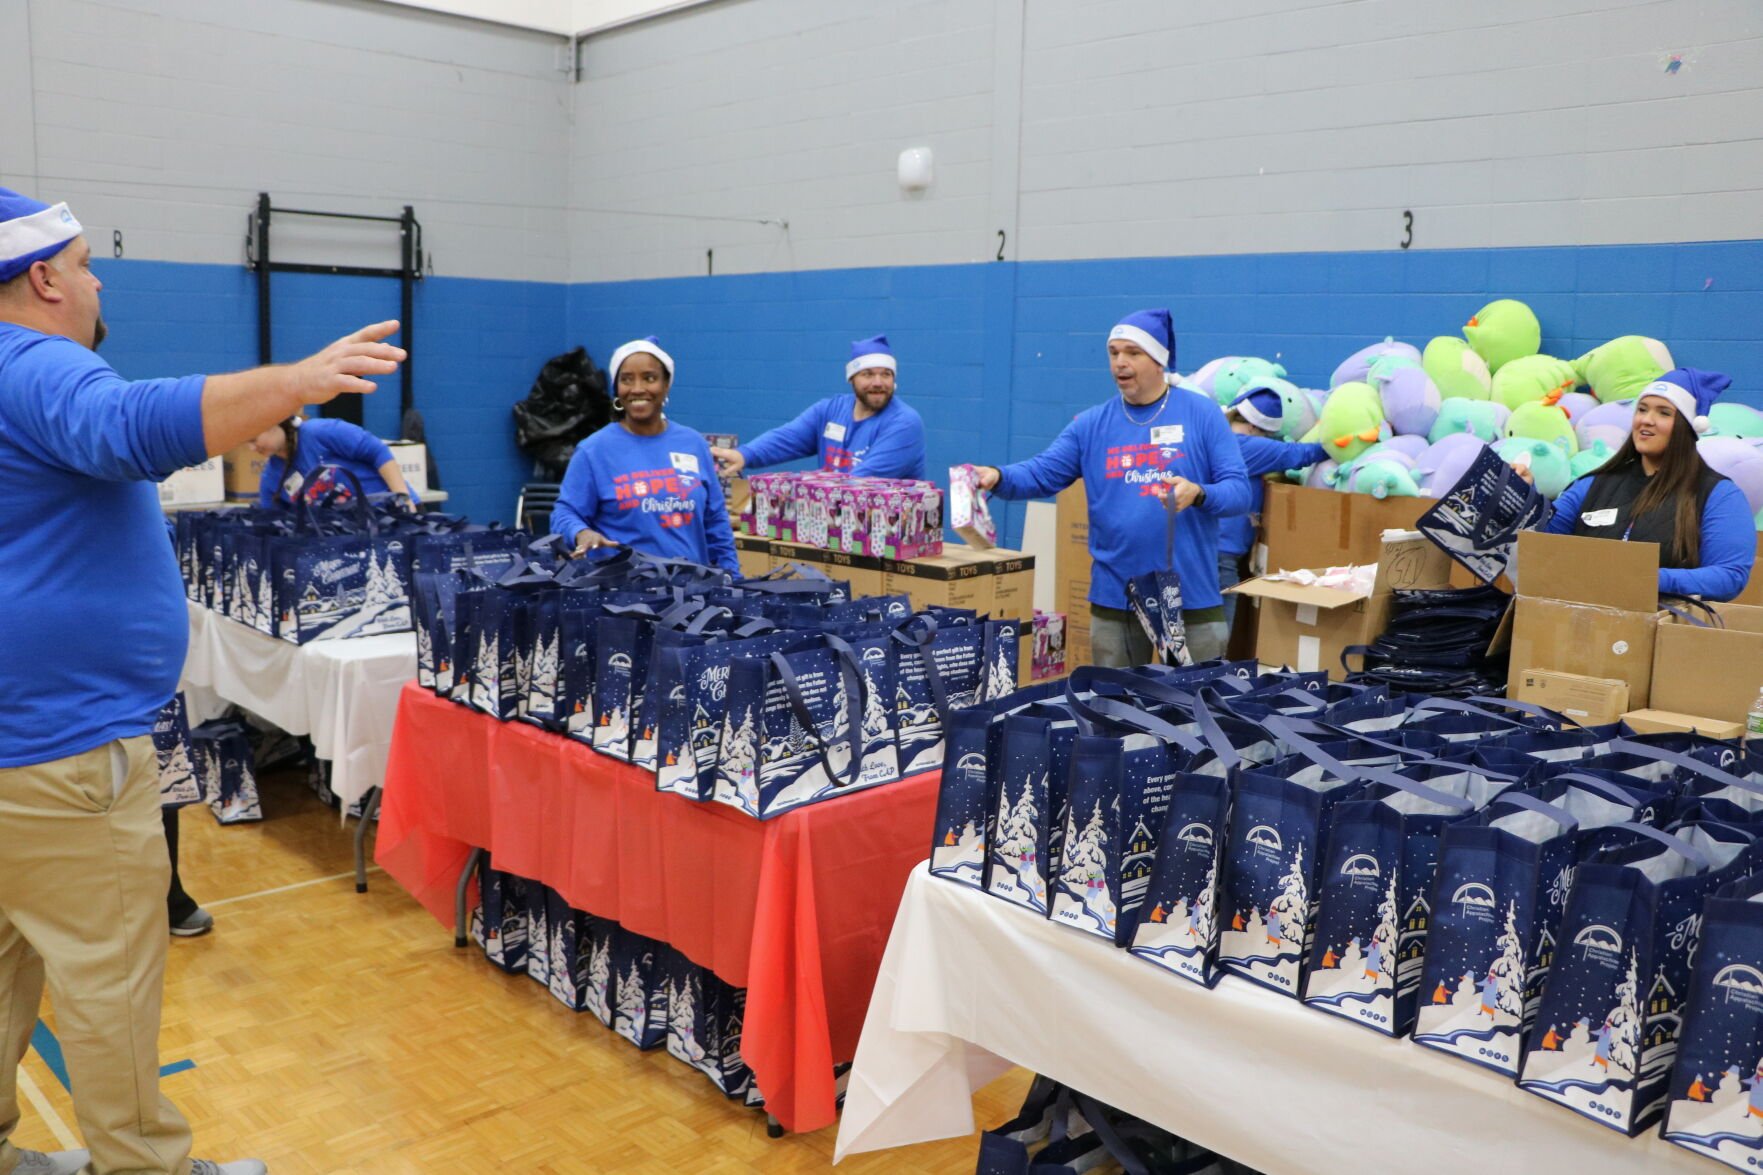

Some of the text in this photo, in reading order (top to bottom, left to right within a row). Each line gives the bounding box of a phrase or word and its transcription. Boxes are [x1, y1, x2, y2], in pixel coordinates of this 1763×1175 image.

[1400, 210, 1413, 249] 3
[113, 230, 123, 258] B
[997, 230, 1006, 261] 2
[1124, 467, 1174, 484] Christmas
[615, 477, 680, 500] HOPE
[641, 496, 696, 513] Christmas
[660, 512, 694, 529] JOY
[780, 546, 796, 557] TOYS
[834, 553, 850, 565] TOYS
[896, 563, 915, 574] TOYS
[960, 565, 978, 577] TOYS
[1006, 560, 1022, 571] TOYS
[1147, 775, 1163, 784] Every
[1143, 786, 1162, 794] above,
[1150, 795, 1161, 803] the
